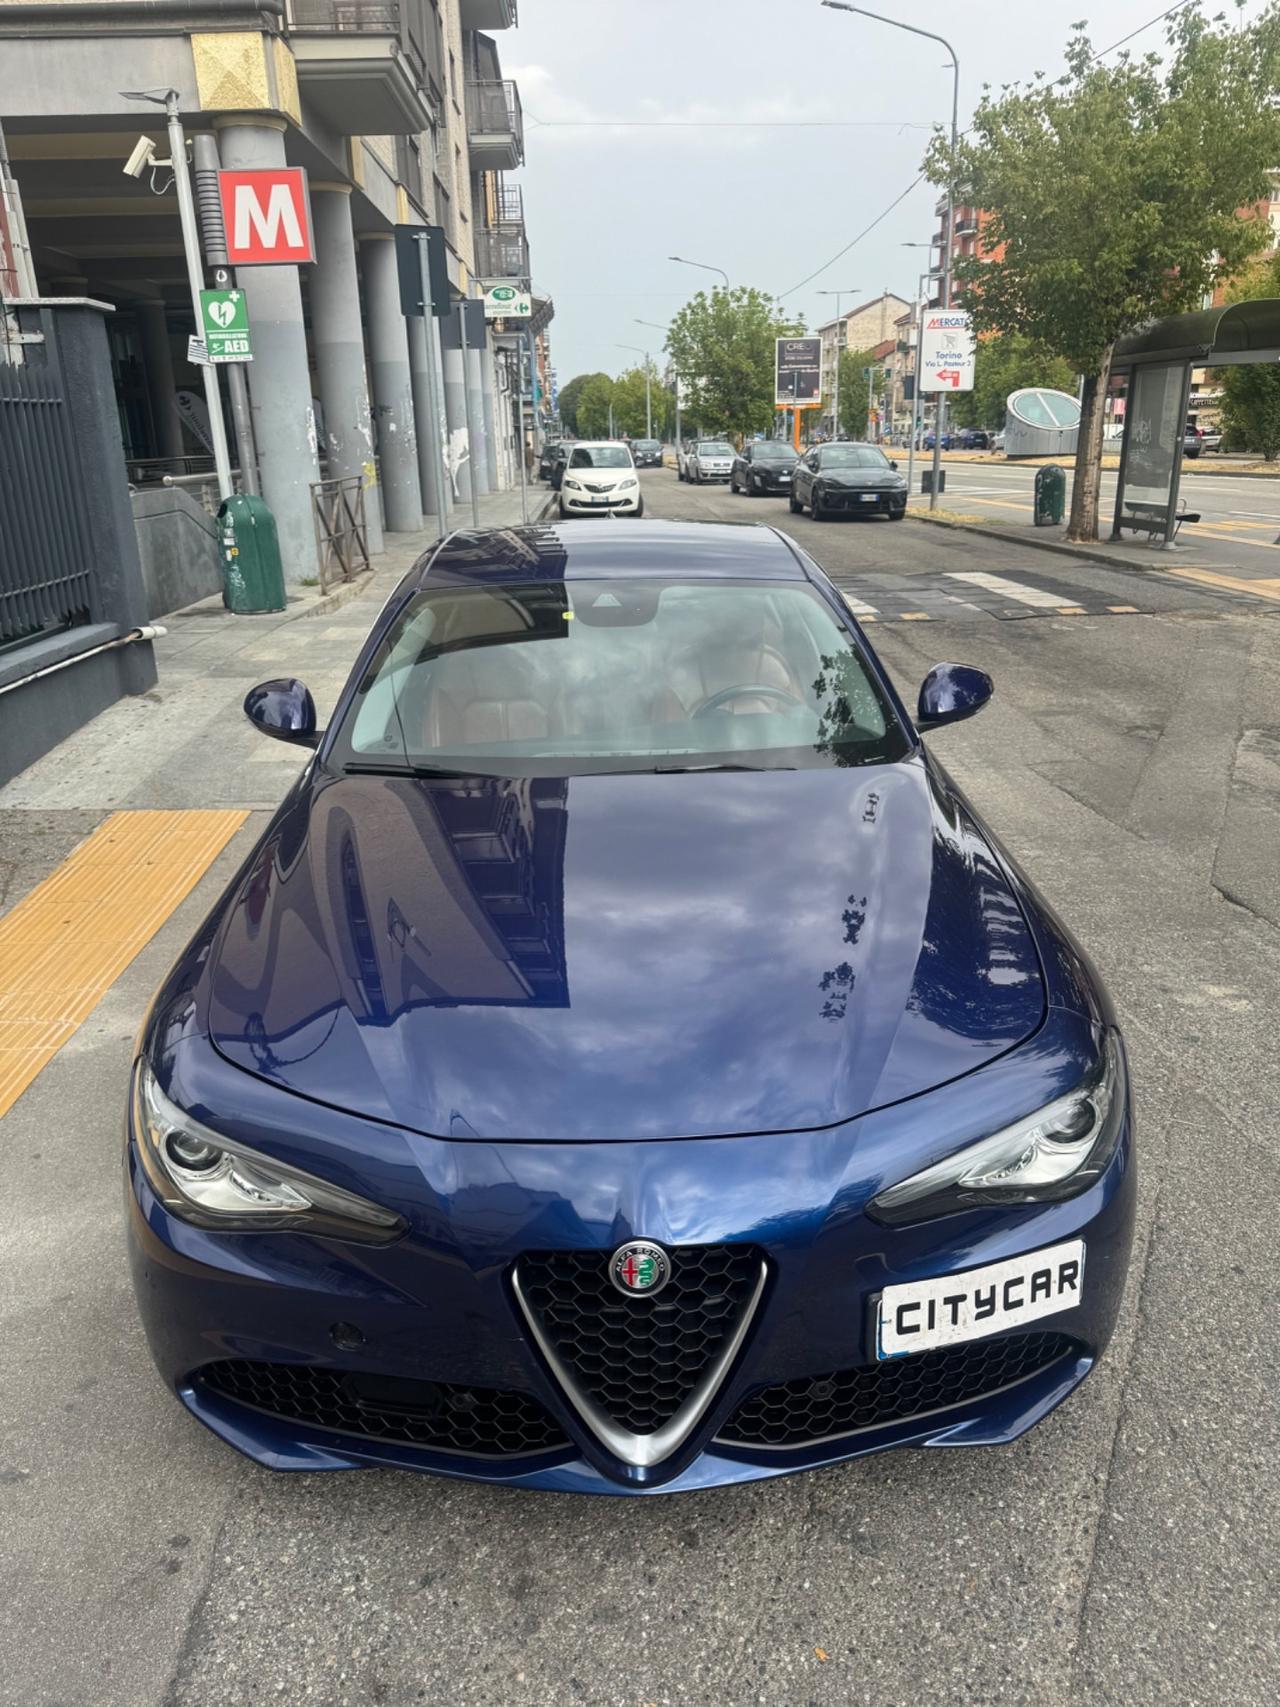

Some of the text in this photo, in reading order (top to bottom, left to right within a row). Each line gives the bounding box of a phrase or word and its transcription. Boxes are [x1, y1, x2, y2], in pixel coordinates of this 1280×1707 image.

[234, 184, 304, 249] M
[224, 340, 250, 353] AED
[935, 350, 963, 360] Torino
[925, 360, 936, 368] Via
[616, 1247, 665, 1272] ALFA ROMEO
[896, 1260, 1079, 1335] CITYCAR
